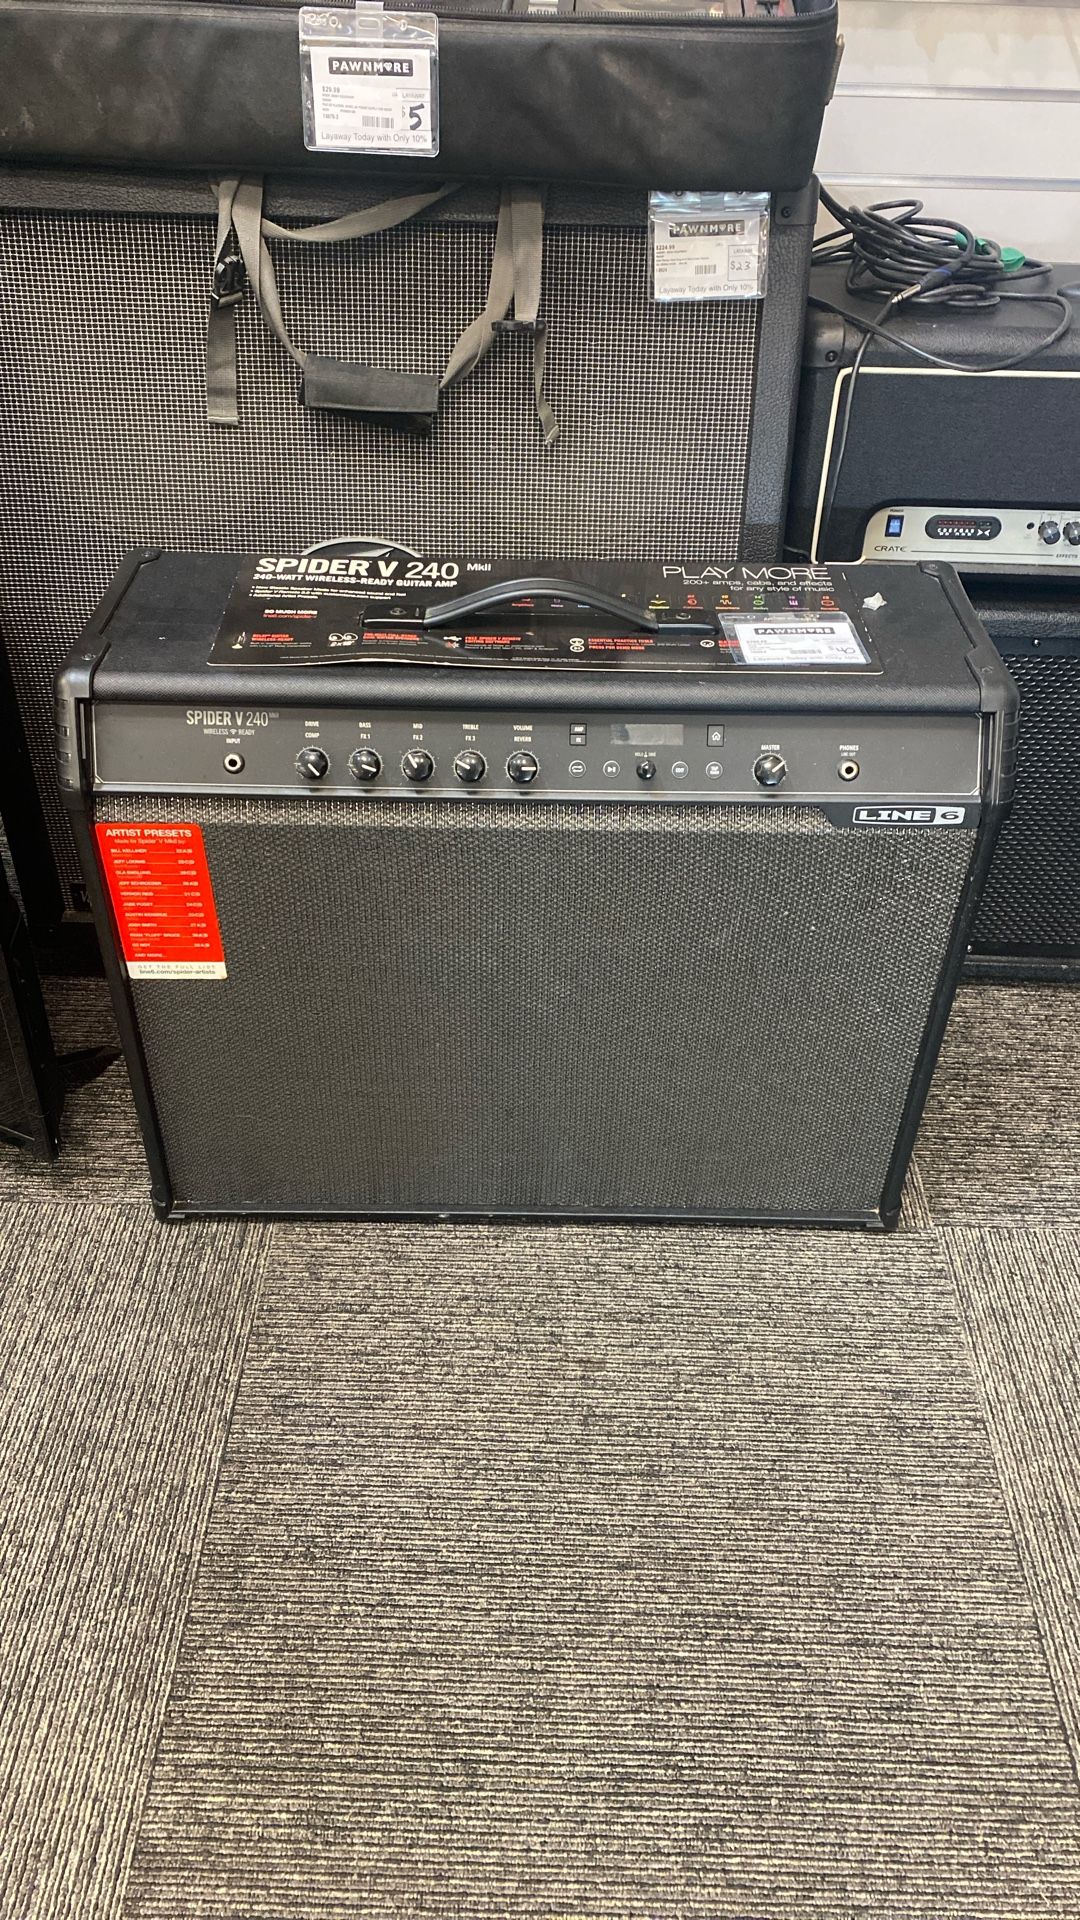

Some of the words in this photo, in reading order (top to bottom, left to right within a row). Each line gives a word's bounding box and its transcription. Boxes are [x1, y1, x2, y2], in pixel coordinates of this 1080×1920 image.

[321, 132, 351, 143] Layaway
[353, 133, 374, 143] Today
[393, 134, 410, 143] Only
[413, 135, 427, 143] 10%
[730, 261, 751, 271] $23
[659, 286, 687, 295] Layaway
[688, 286, 707, 294] Today
[723, 283, 738, 292] Only
[740, 283, 753, 291] 10%
[256, 558, 371, 576] SPIDER
[378, 561, 399, 577] V
[405, 562, 459, 579] 240
[467, 563, 491, 571] MkII
[662, 566, 735, 579] PLAY
[742, 567, 831, 580] MORE
[253, 573, 304, 581] 240-WATT
[305, 574, 394, 586] WIRELESS-READY
[186, 710, 232, 725] SPIDER
[235, 711, 243, 726] V
[246, 712, 269, 726] 240
[859, 810, 932, 821] LINE
[940, 810, 959, 820] 6
[105, 829, 142, 837] ARTIST
[144, 829, 192, 838] PRESETS
